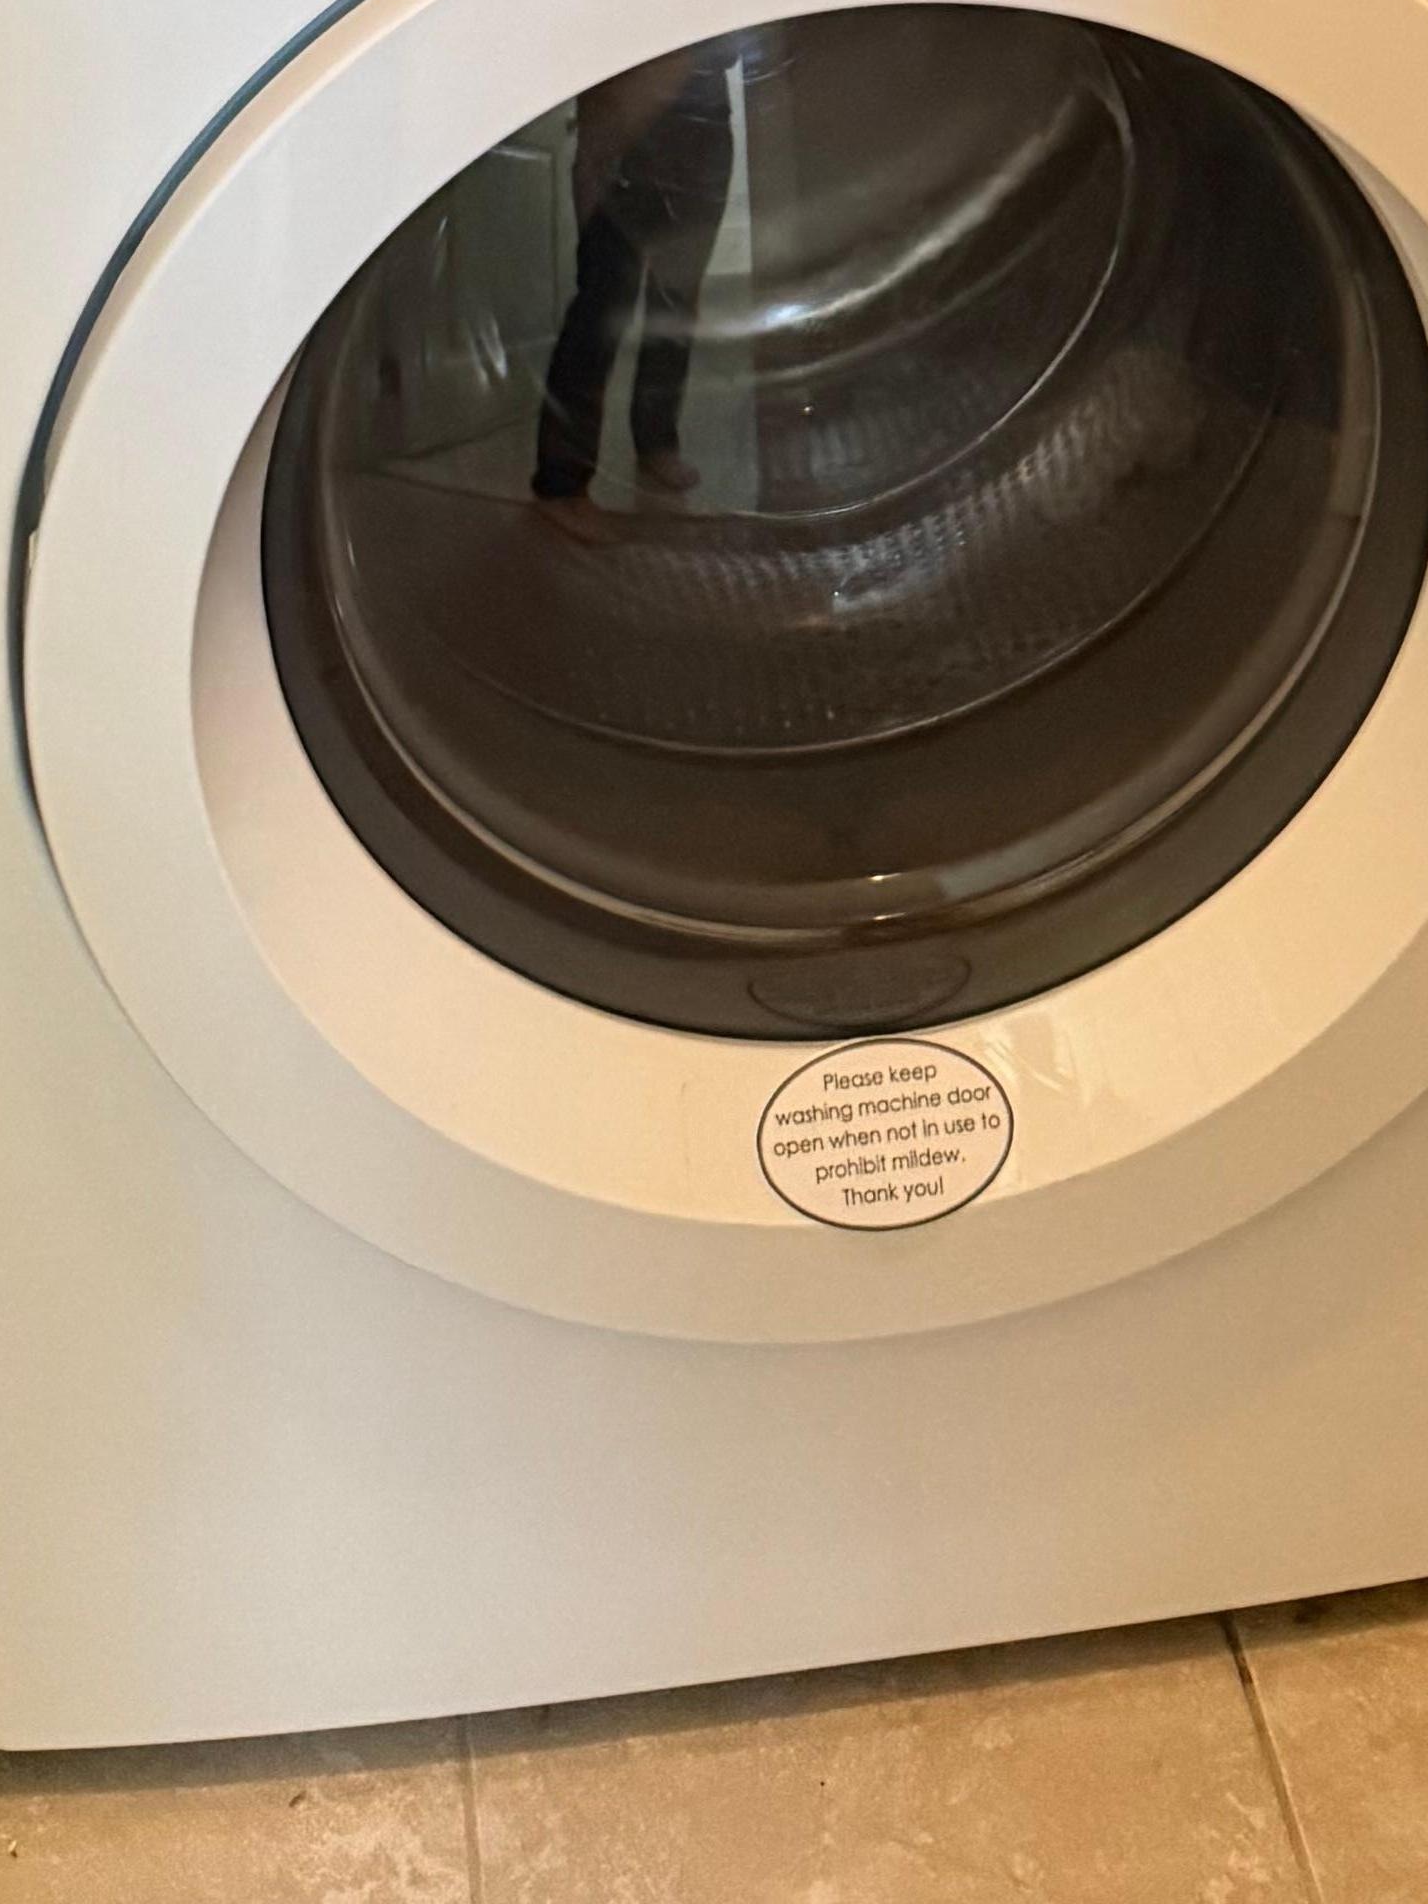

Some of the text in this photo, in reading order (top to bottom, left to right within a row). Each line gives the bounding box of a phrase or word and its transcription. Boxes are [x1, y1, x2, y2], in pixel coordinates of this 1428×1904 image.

[823, 1064, 937, 1091] Please keep
[775, 1083, 991, 1126] washing machine door
[773, 1111, 1001, 1159] open when not in use to
[815, 1148, 966, 1183] prohibit mildew.
[841, 1176, 944, 1207] Thank you!
